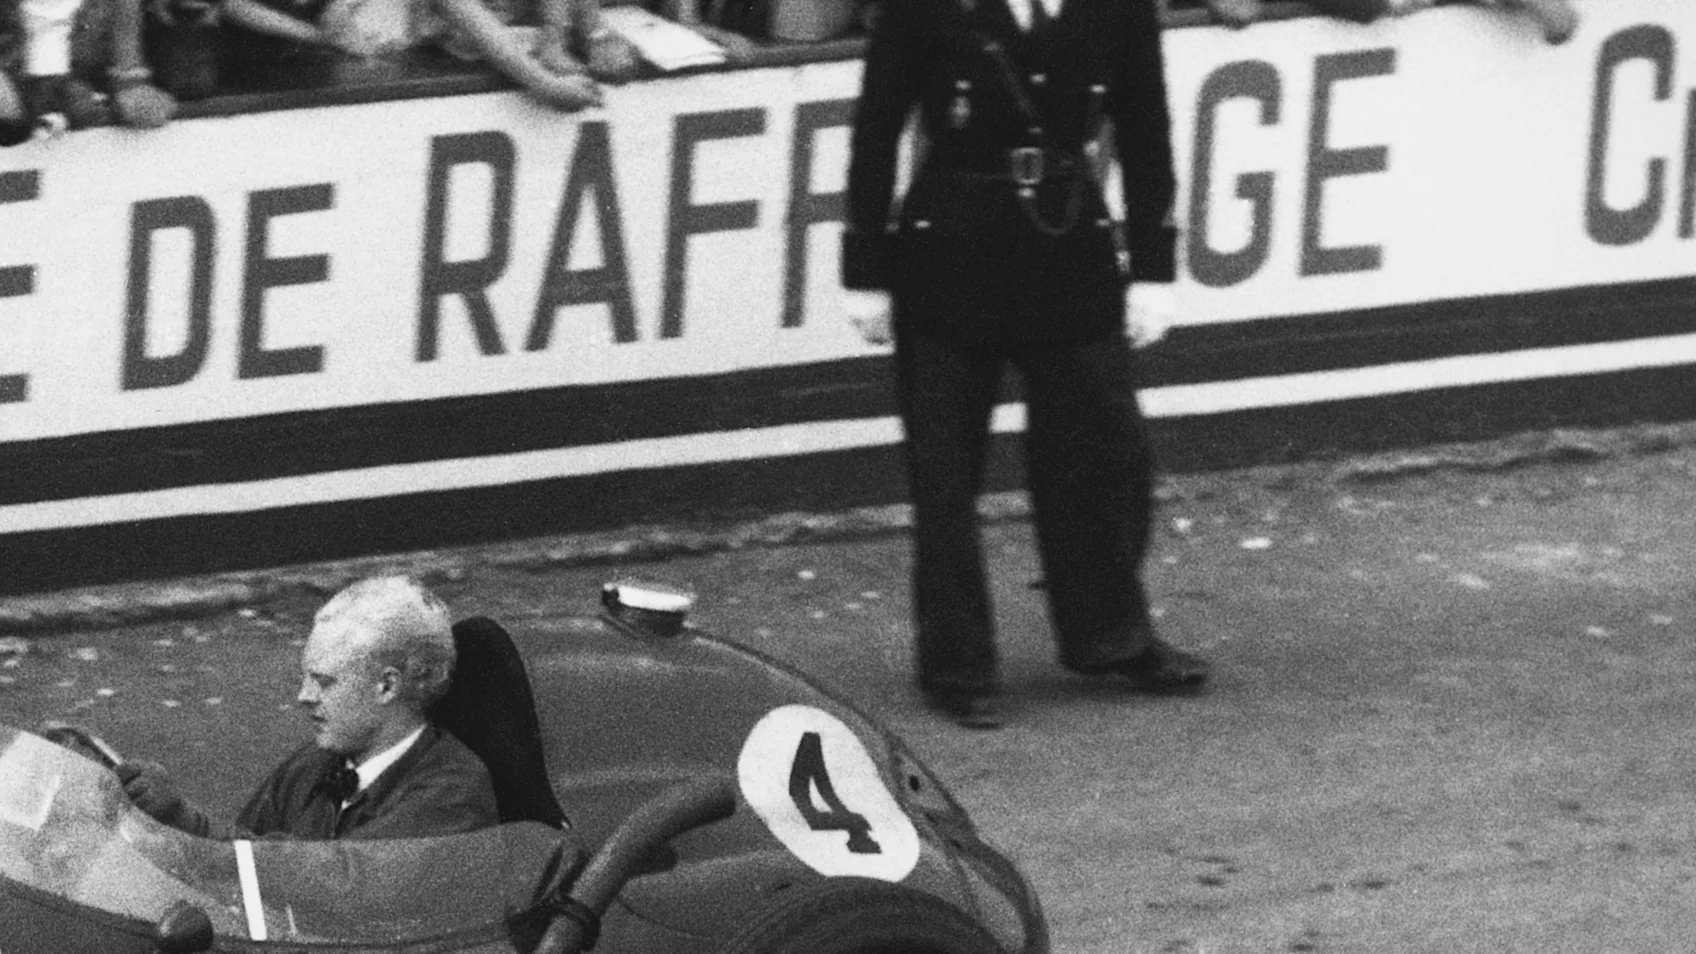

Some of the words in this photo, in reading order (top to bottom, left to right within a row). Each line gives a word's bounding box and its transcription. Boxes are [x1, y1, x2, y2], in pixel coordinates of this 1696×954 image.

[119, 182, 335, 391] DE
[414, 46, 1399, 364] RAFFGE
[1585, 22, 1696, 246] C
[788, 730, 883, 855] 4
